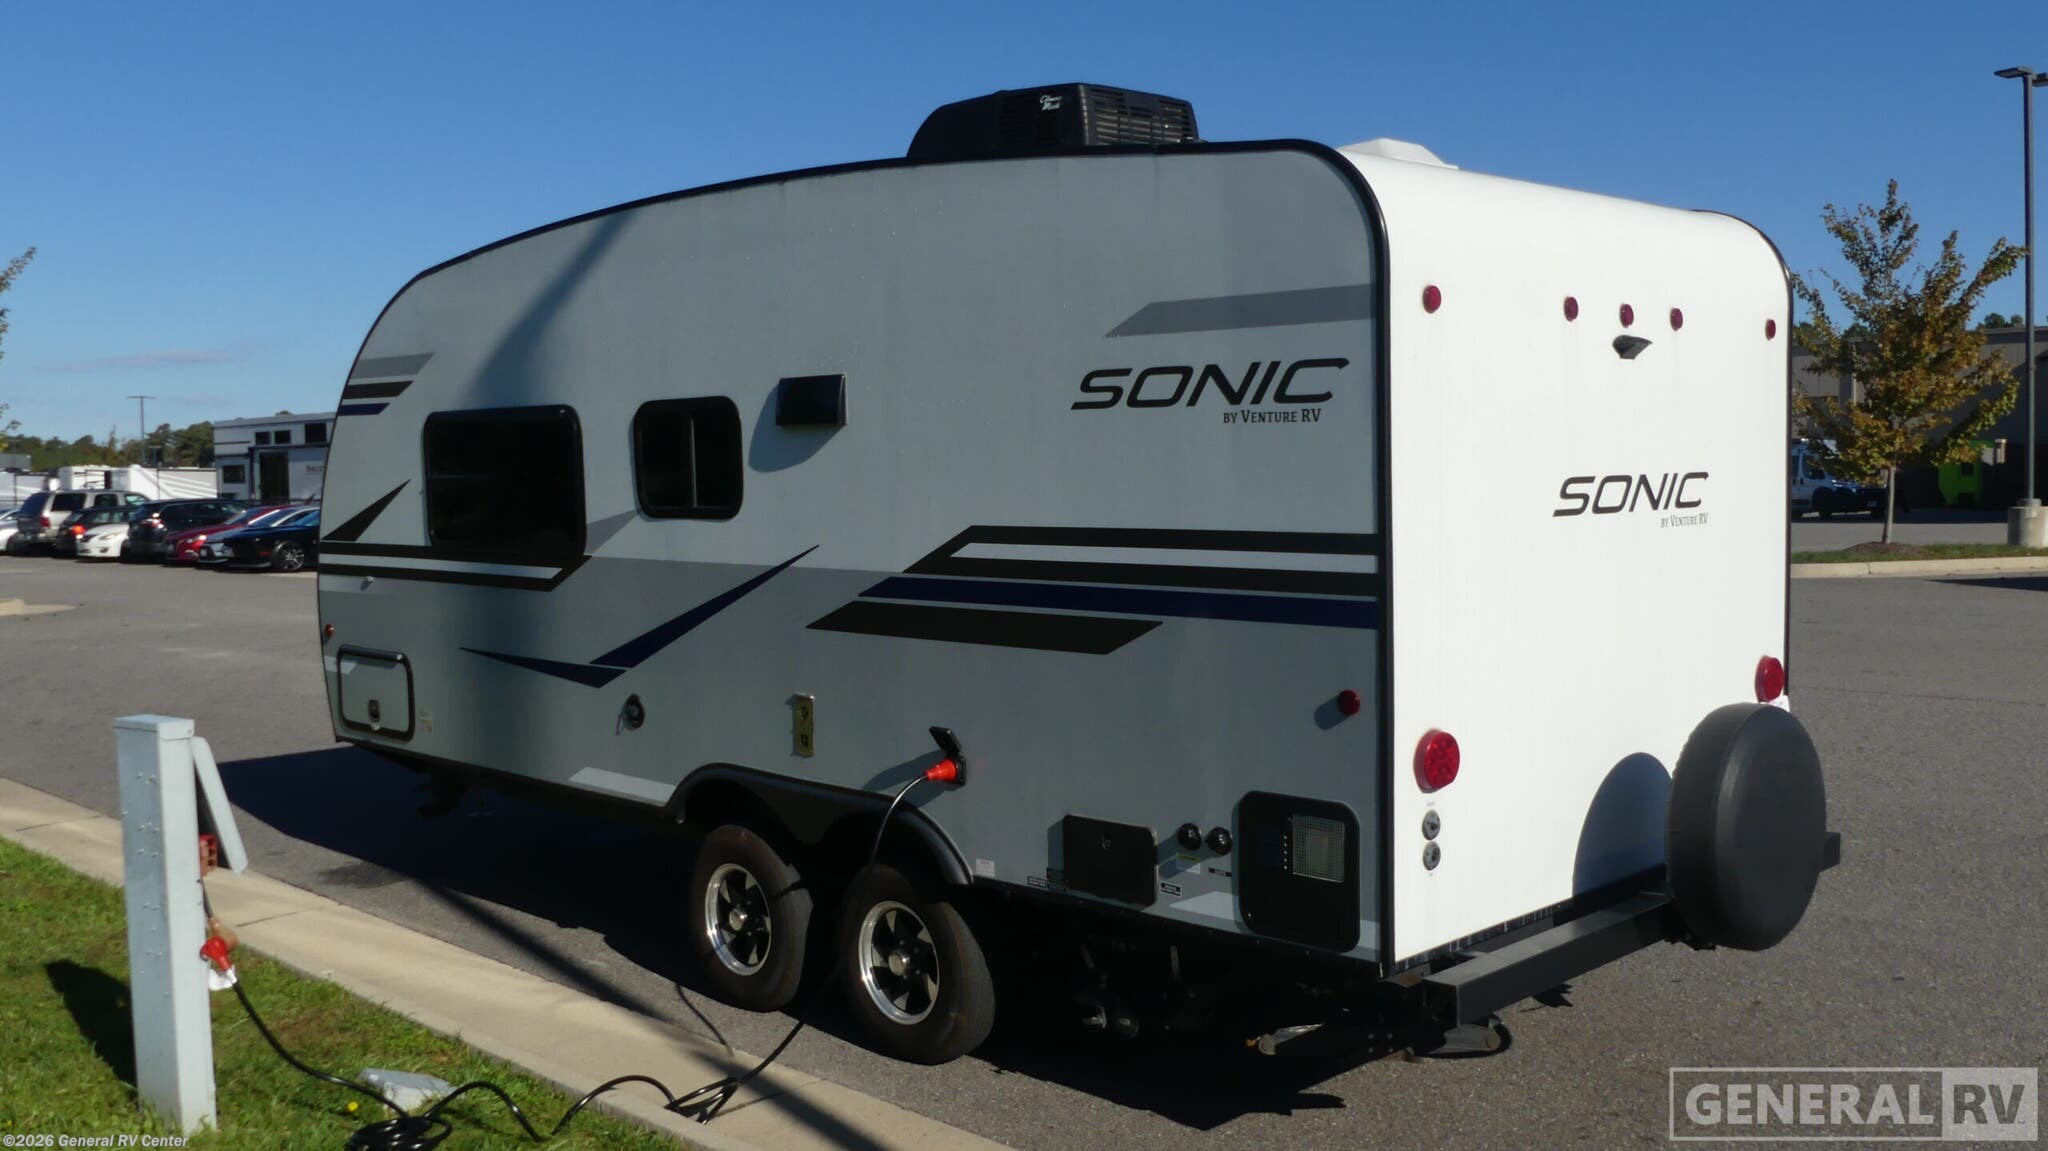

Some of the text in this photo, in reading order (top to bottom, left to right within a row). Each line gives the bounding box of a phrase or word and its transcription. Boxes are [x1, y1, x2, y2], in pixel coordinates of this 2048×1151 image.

[1070, 357, 1350, 410] SONIC
[1223, 408, 1322, 424] BY VENTURE RV
[1552, 471, 1709, 517] SONIC
